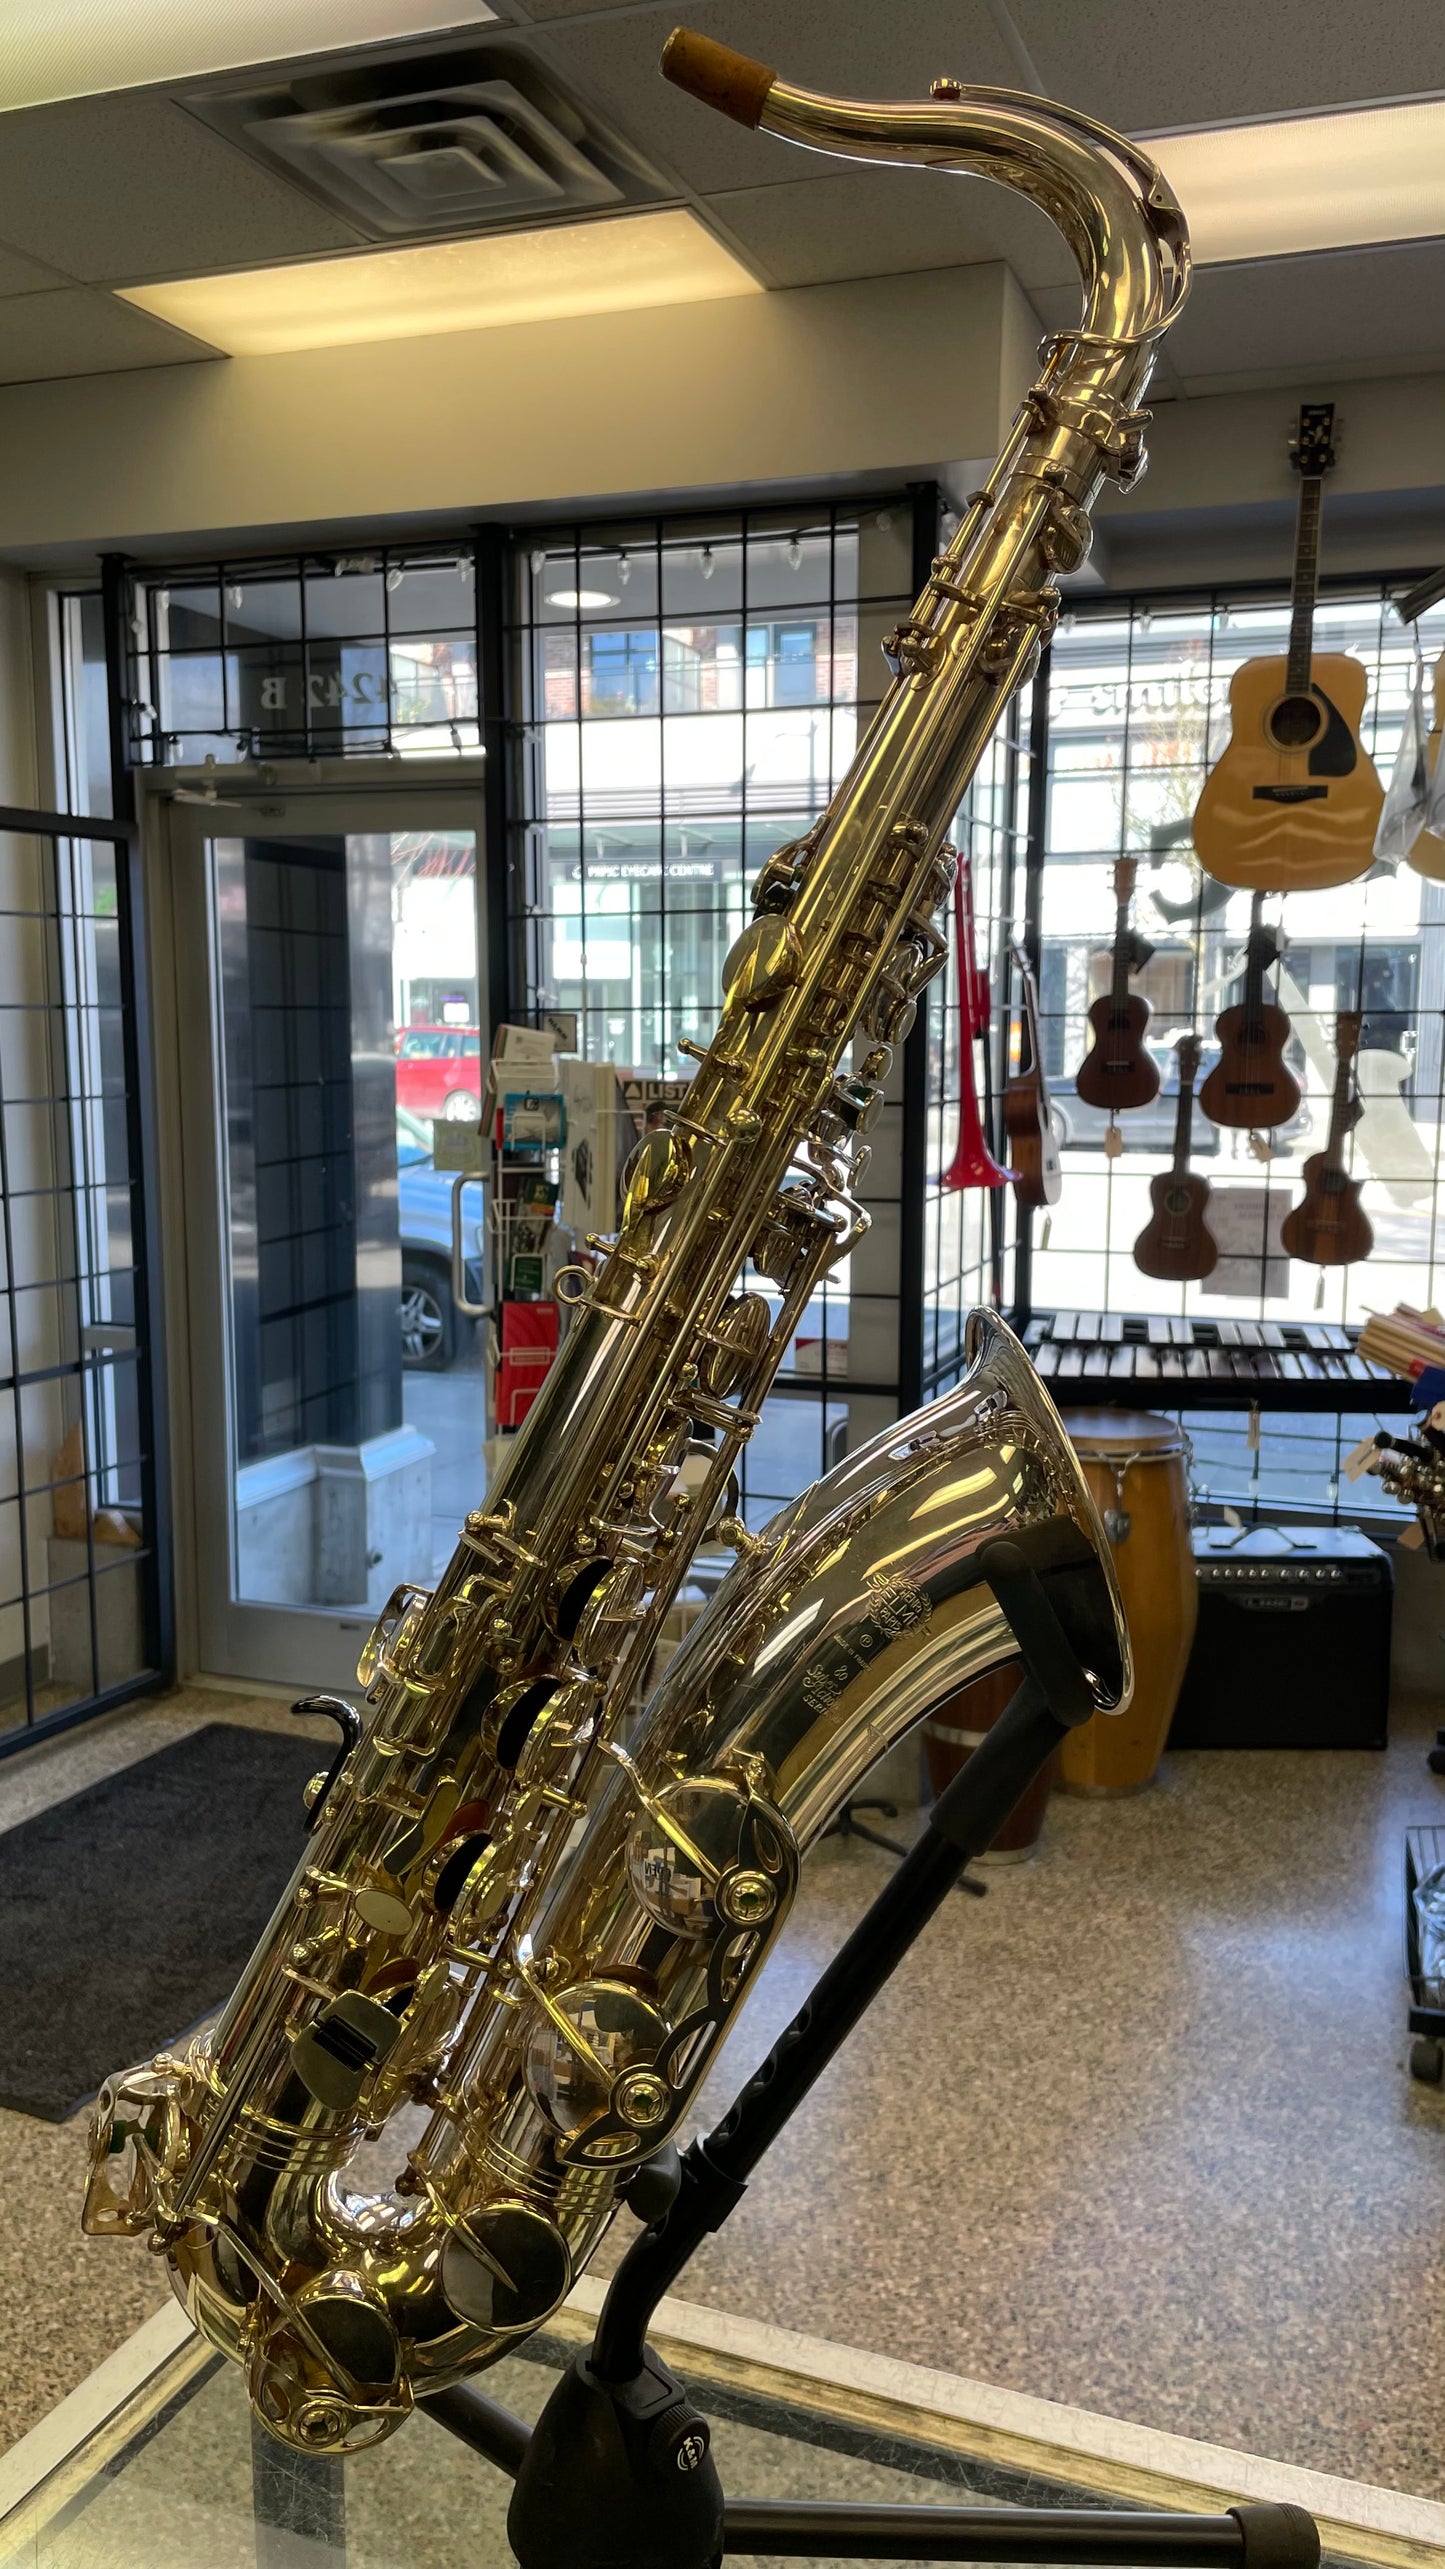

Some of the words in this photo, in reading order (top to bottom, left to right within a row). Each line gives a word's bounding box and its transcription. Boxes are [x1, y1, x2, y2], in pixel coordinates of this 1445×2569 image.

[866, 1573, 932, 1636] SELMER
[899, 1588, 923, 1613] HENRI
[880, 1606, 903, 1631] PARIS
[833, 1664, 849, 1681] 80
